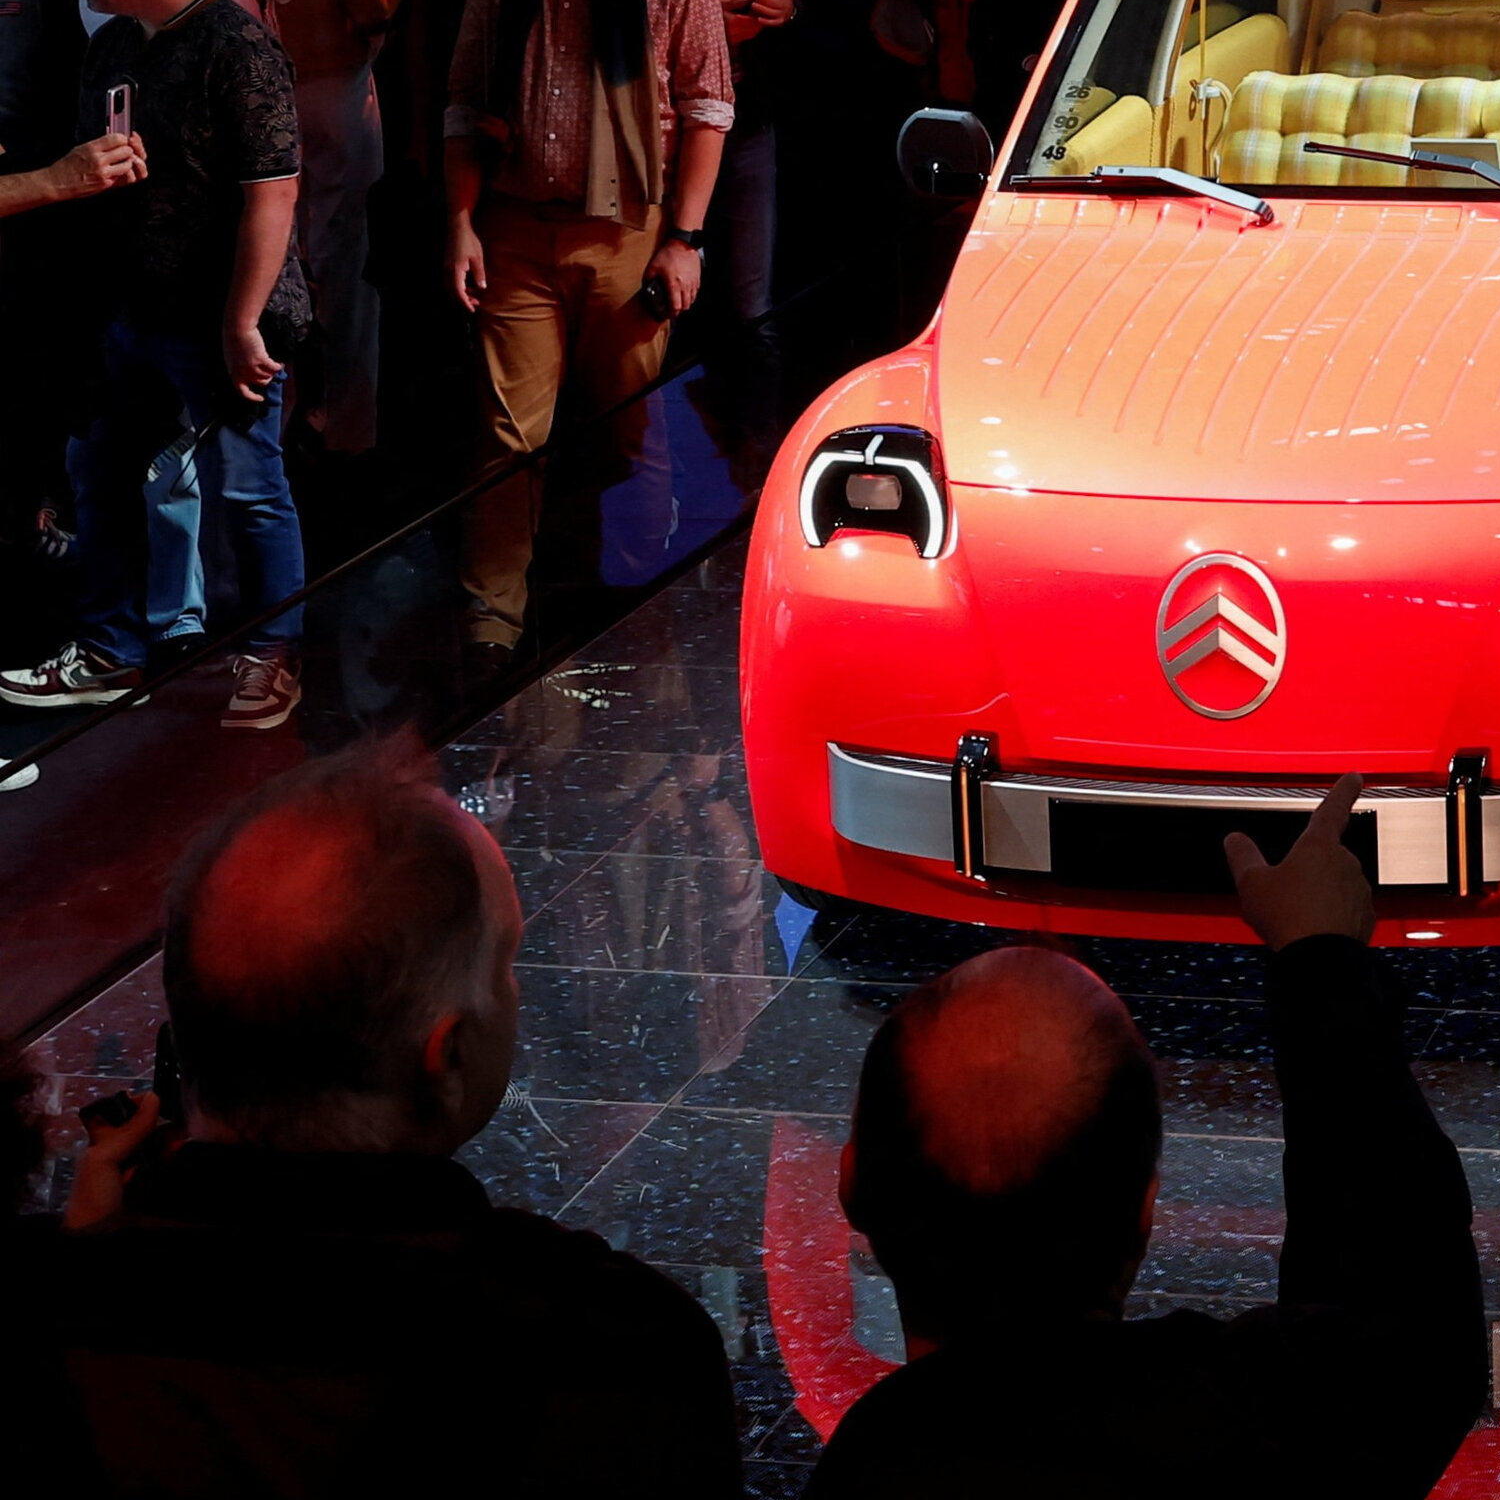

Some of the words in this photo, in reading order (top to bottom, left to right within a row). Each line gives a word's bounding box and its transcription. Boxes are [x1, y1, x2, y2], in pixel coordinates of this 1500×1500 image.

[1065, 85, 1091, 99] 26
[1053, 115, 1079, 130] 90
[1042, 145, 1067, 160] 48
